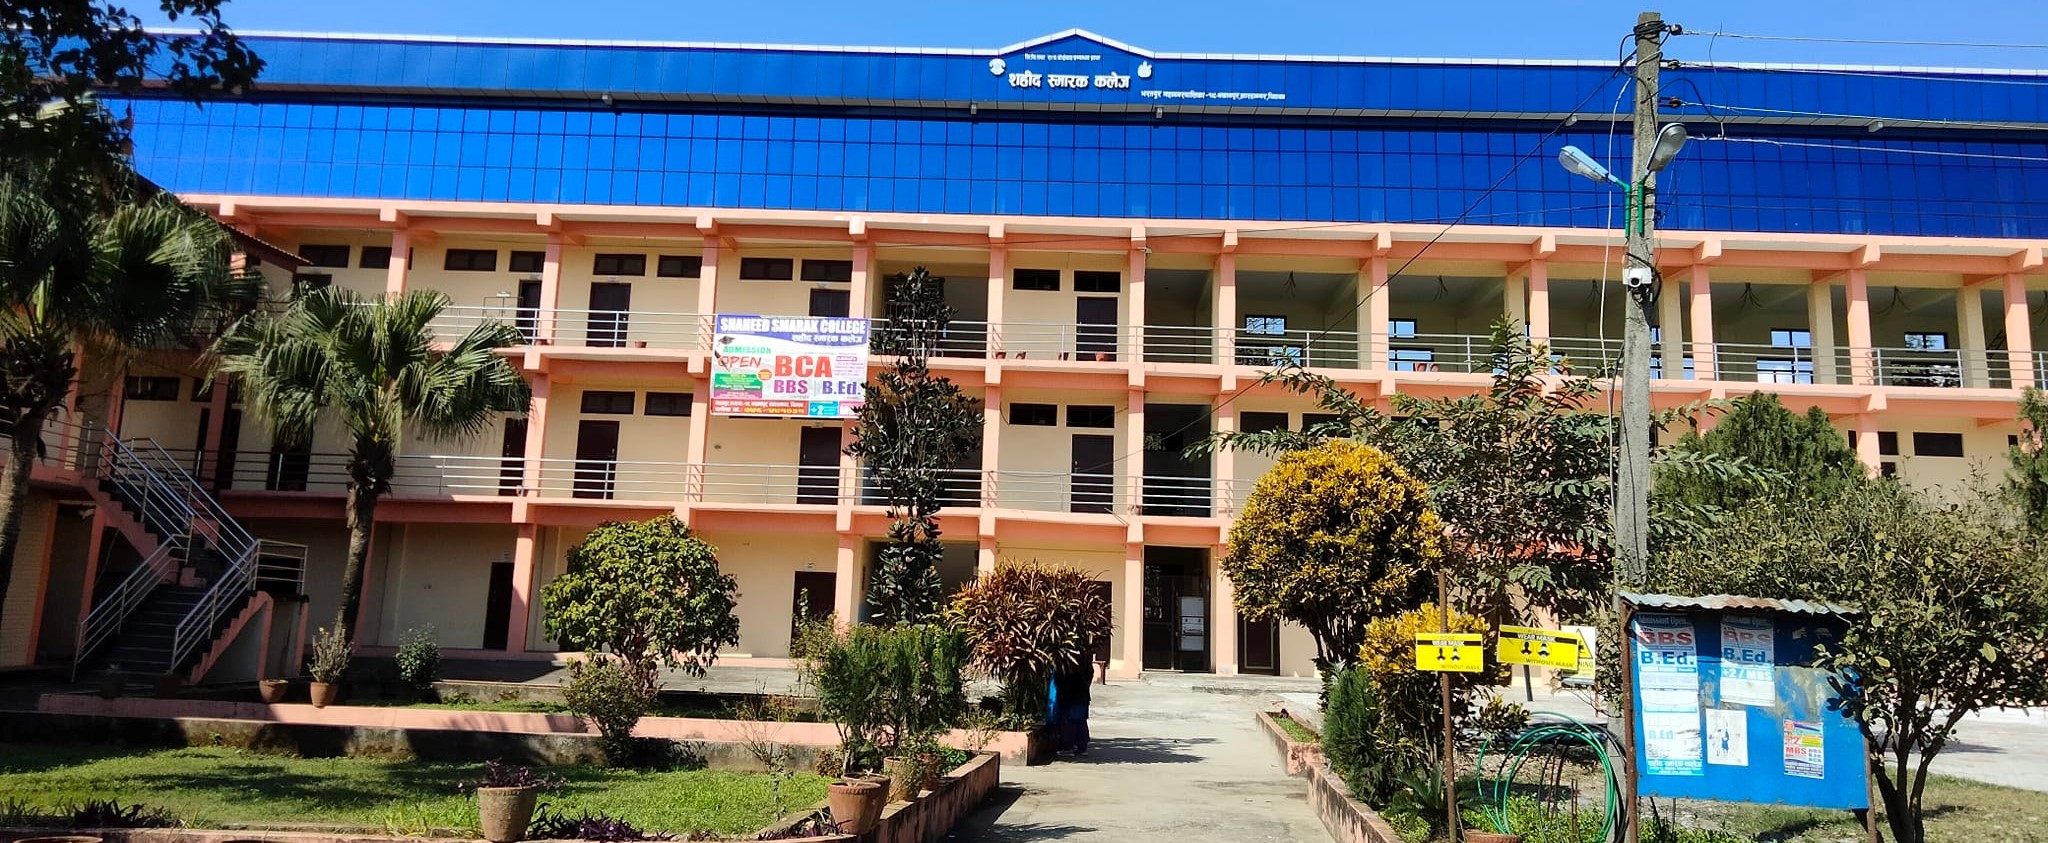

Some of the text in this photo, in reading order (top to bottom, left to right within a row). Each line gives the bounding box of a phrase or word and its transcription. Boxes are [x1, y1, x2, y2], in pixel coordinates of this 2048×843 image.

[1008, 69, 1131, 89] शहीद स्मारक कलेज
[720, 317, 866, 334] SHAHEED SMARAK COLLEGE
[723, 345, 772, 355] ADMISSION
[718, 355, 762, 368] OPEN
[774, 355, 833, 378] BCA
[773, 379, 809, 394] BBS
[822, 380, 861, 395] B.Ed.
[1517, 633, 1556, 643] WEAR MASK
[1640, 631, 1693, 646] BBS
[1525, 658, 1554, 667] WITHOUT
[1641, 650, 1695, 665] B.Ed.
[1723, 647, 1772, 663] B.Ed.
[1785, 746, 1807, 755] MBS
